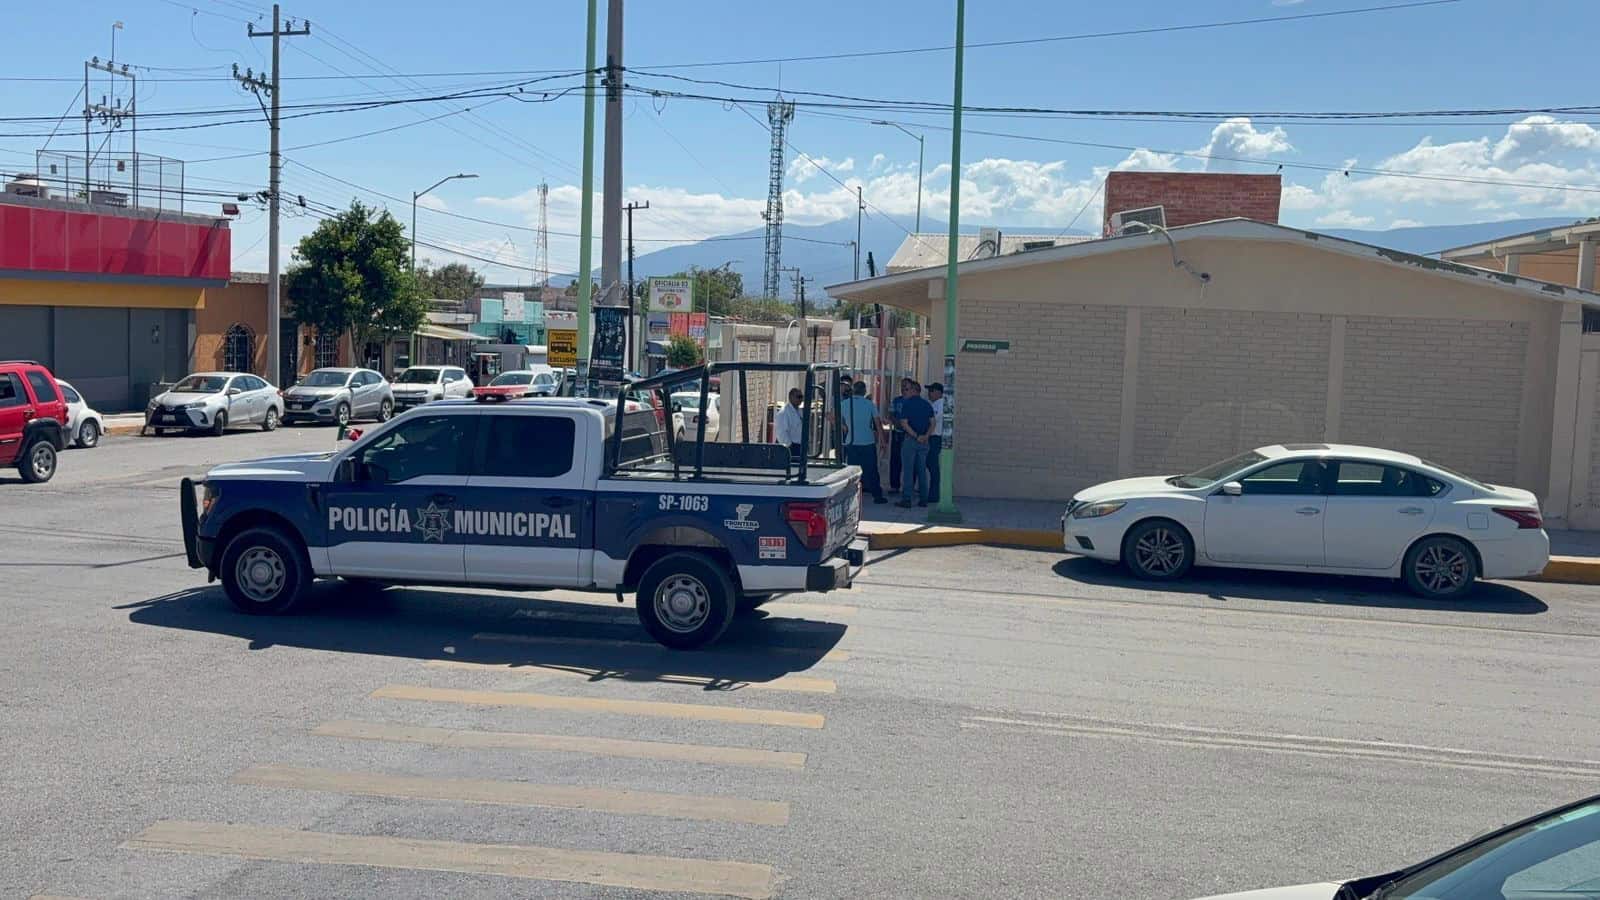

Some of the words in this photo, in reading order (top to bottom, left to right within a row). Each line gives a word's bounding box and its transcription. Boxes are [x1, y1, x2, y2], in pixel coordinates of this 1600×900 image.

[658, 494, 709, 512] SP-1063
[328, 502, 411, 533] POLICÍA
[454, 510, 576, 539] MUNICIPAL
